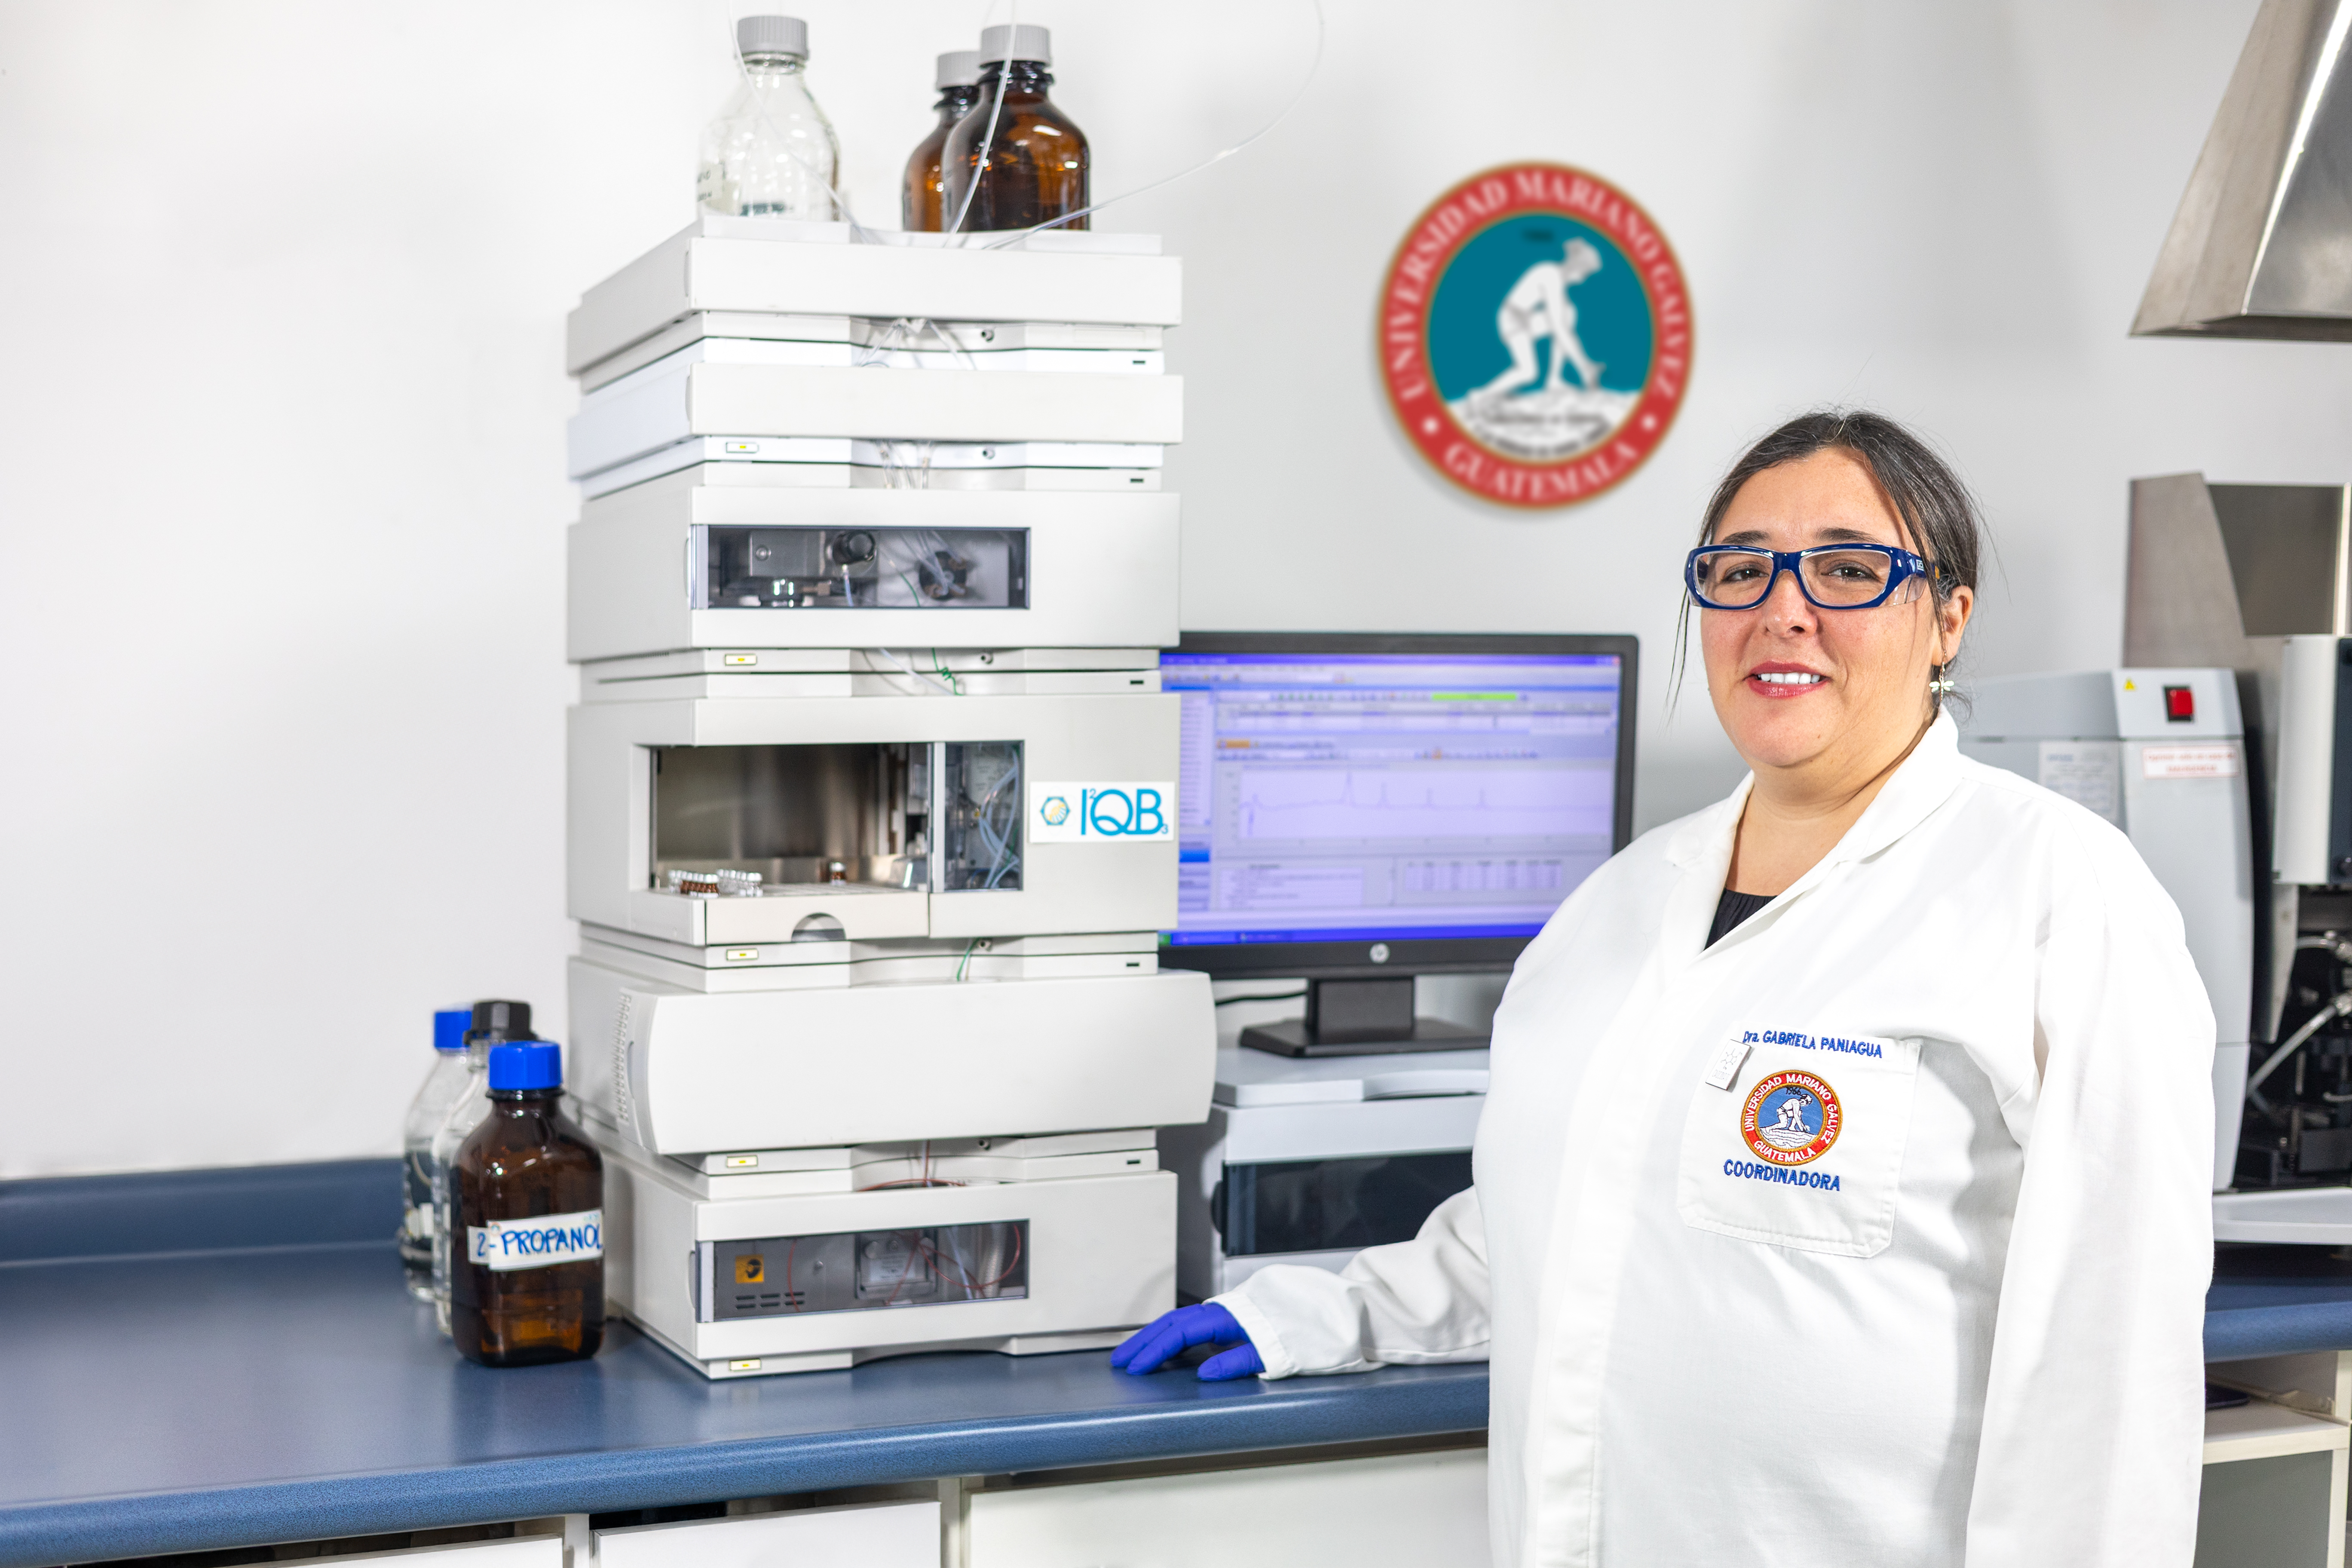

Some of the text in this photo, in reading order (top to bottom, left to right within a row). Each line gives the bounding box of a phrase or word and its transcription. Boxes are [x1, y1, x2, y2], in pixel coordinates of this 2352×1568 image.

[1387, 177, 1509, 401] UNIVERSIDAD
[1513, 168, 1662, 261] MARIANO
[1443, 441, 1638, 499] GUATEMALA
[1742, 1030, 1882, 1059] Dra. GABRIELA PANIAGUA
[1785, 1087, 1802, 1096] 1966
[1744, 1074, 1838, 1144] UNIVERSIDAD MARIANO GALVEZ
[1754, 1140, 1816, 1162] GUATEMALA
[1723, 1159, 1841, 1191] COORDINADORA
